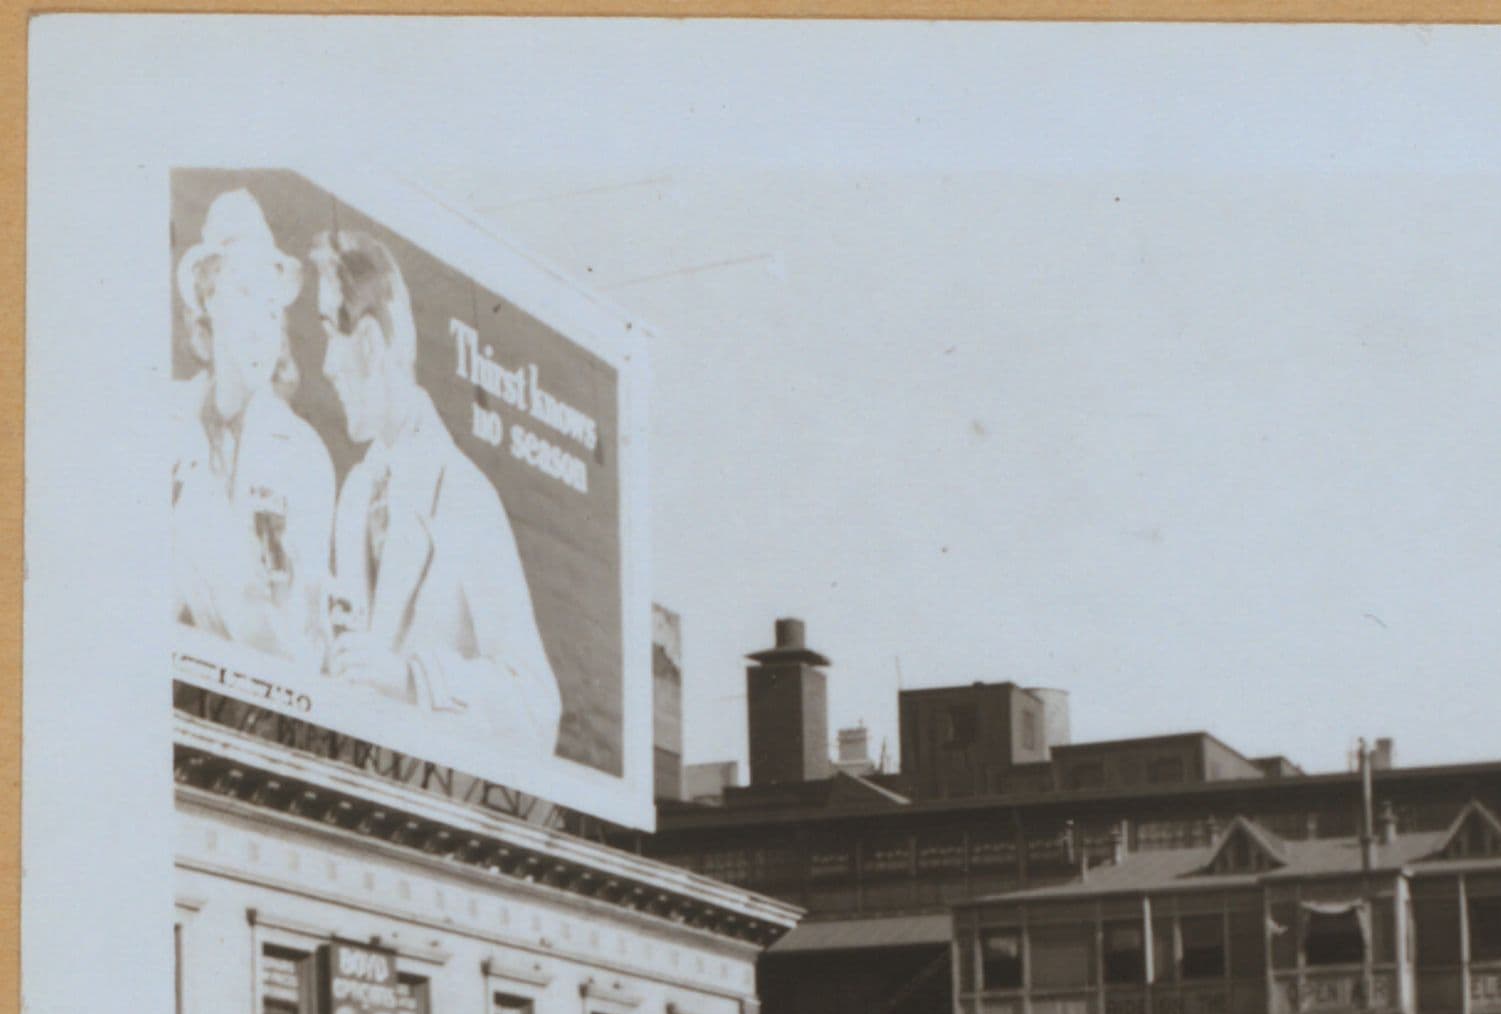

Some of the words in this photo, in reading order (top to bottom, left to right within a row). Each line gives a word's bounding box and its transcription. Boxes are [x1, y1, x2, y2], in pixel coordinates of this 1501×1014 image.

[449, 316, 527, 412] Thirst
[529, 362, 598, 452] knows
[471, 402, 503, 448] no
[508, 423, 589, 495] season
